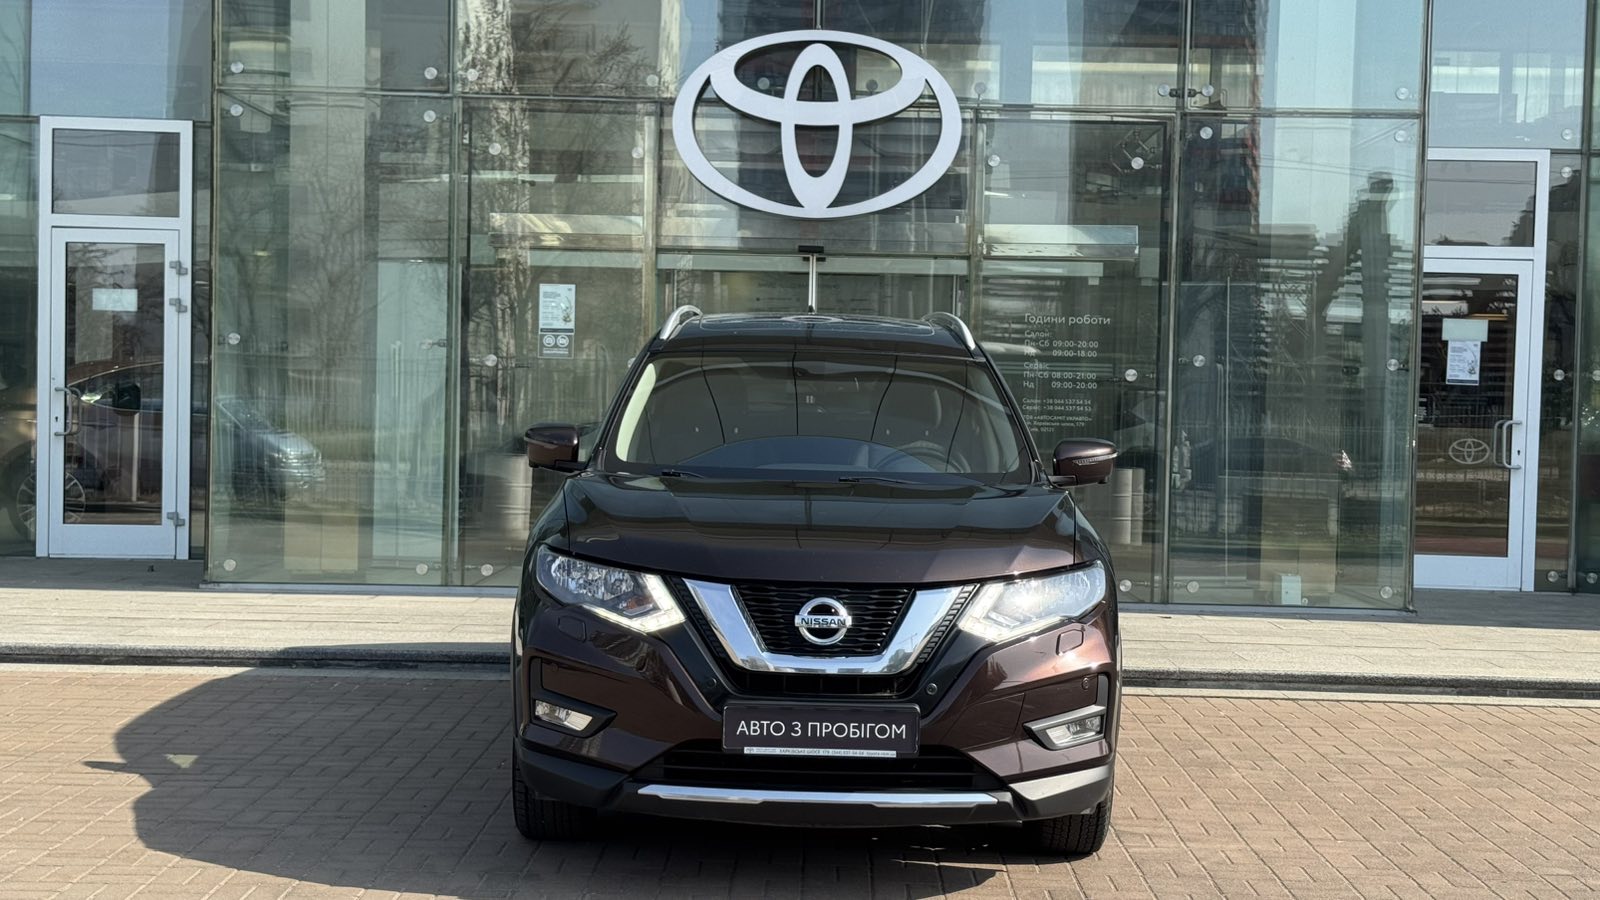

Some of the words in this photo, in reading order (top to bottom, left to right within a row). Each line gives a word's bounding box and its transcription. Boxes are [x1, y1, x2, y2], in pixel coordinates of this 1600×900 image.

[1024, 313, 1065, 324] Години
[1068, 314, 1111, 326] роботи
[1024, 340, 1050, 348] Пн-Сб
[1052, 340, 1099, 348] 09:00-20:00
[1052, 349, 1098, 357] 09:00-18:00
[1023, 371, 1049, 379] Пн-Сб
[1051, 372, 1097, 380] 08:00-21:00
[1023, 381, 1035, 389] Нд
[1051, 381, 1098, 389] 09:00-20:00
[801, 617, 846, 626] NISSAN
[736, 720, 785, 736] АВТО
[808, 722, 906, 739] ПРОБІГОМ
